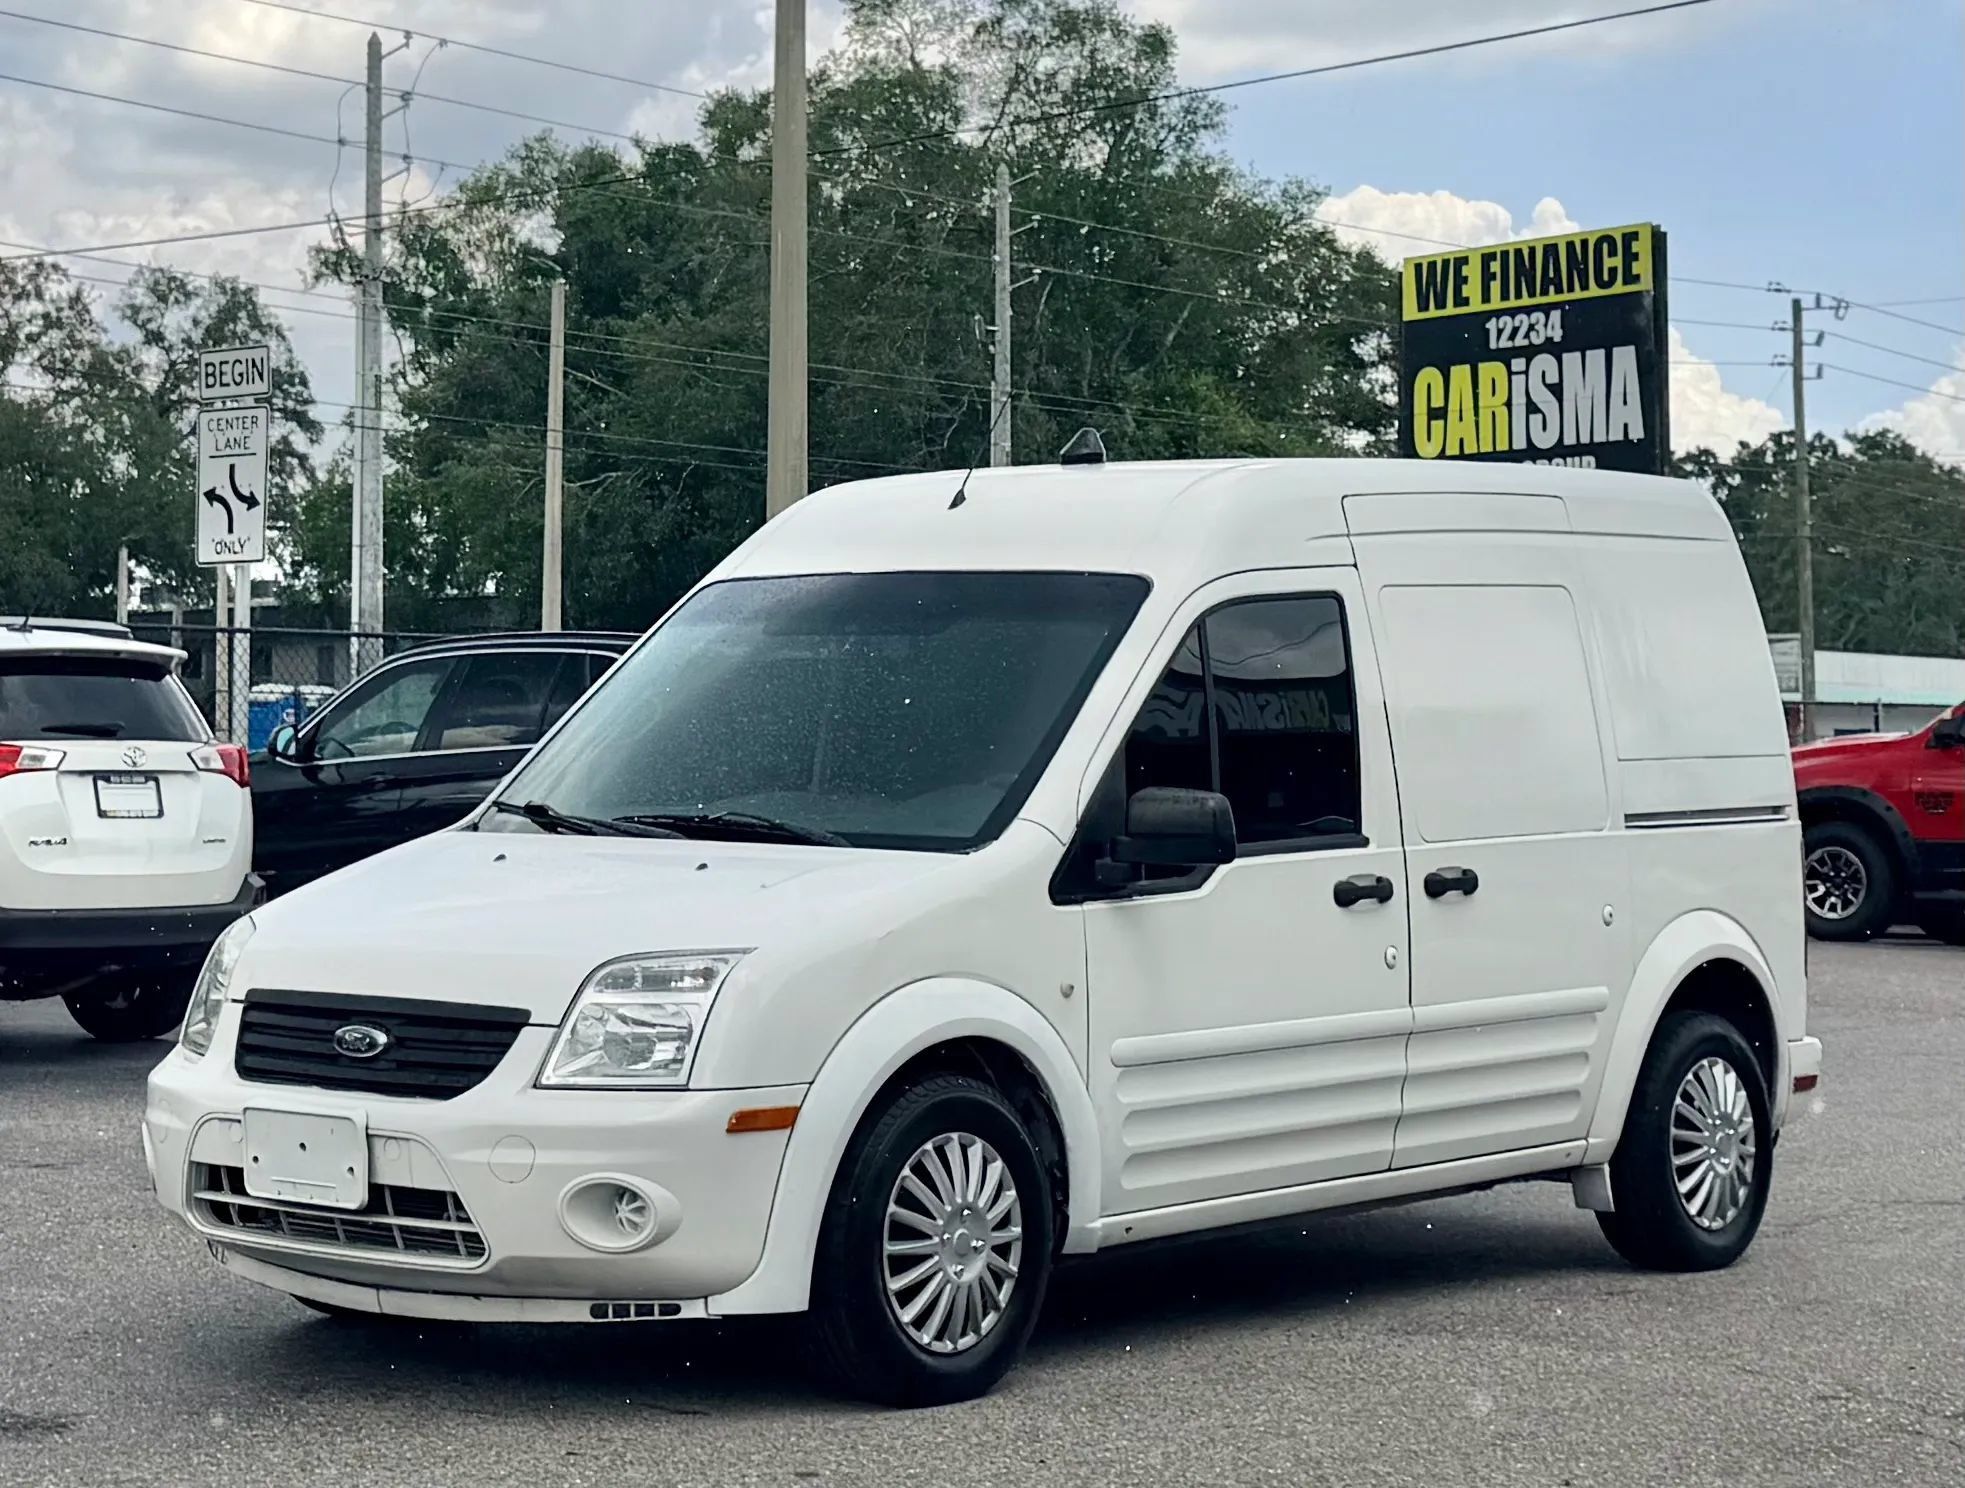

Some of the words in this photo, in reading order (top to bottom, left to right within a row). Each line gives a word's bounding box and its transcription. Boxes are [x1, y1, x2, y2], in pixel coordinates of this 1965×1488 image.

[1414, 255, 1470, 313] WE
[1481, 230, 1641, 304] FINANCE
[1485, 309, 1563, 350] 12234
[204, 357, 266, 389] BEGIN
[207, 415, 259, 433] CENTER
[214, 435, 251, 452] LANE
[214, 536, 247, 555] ONLY
